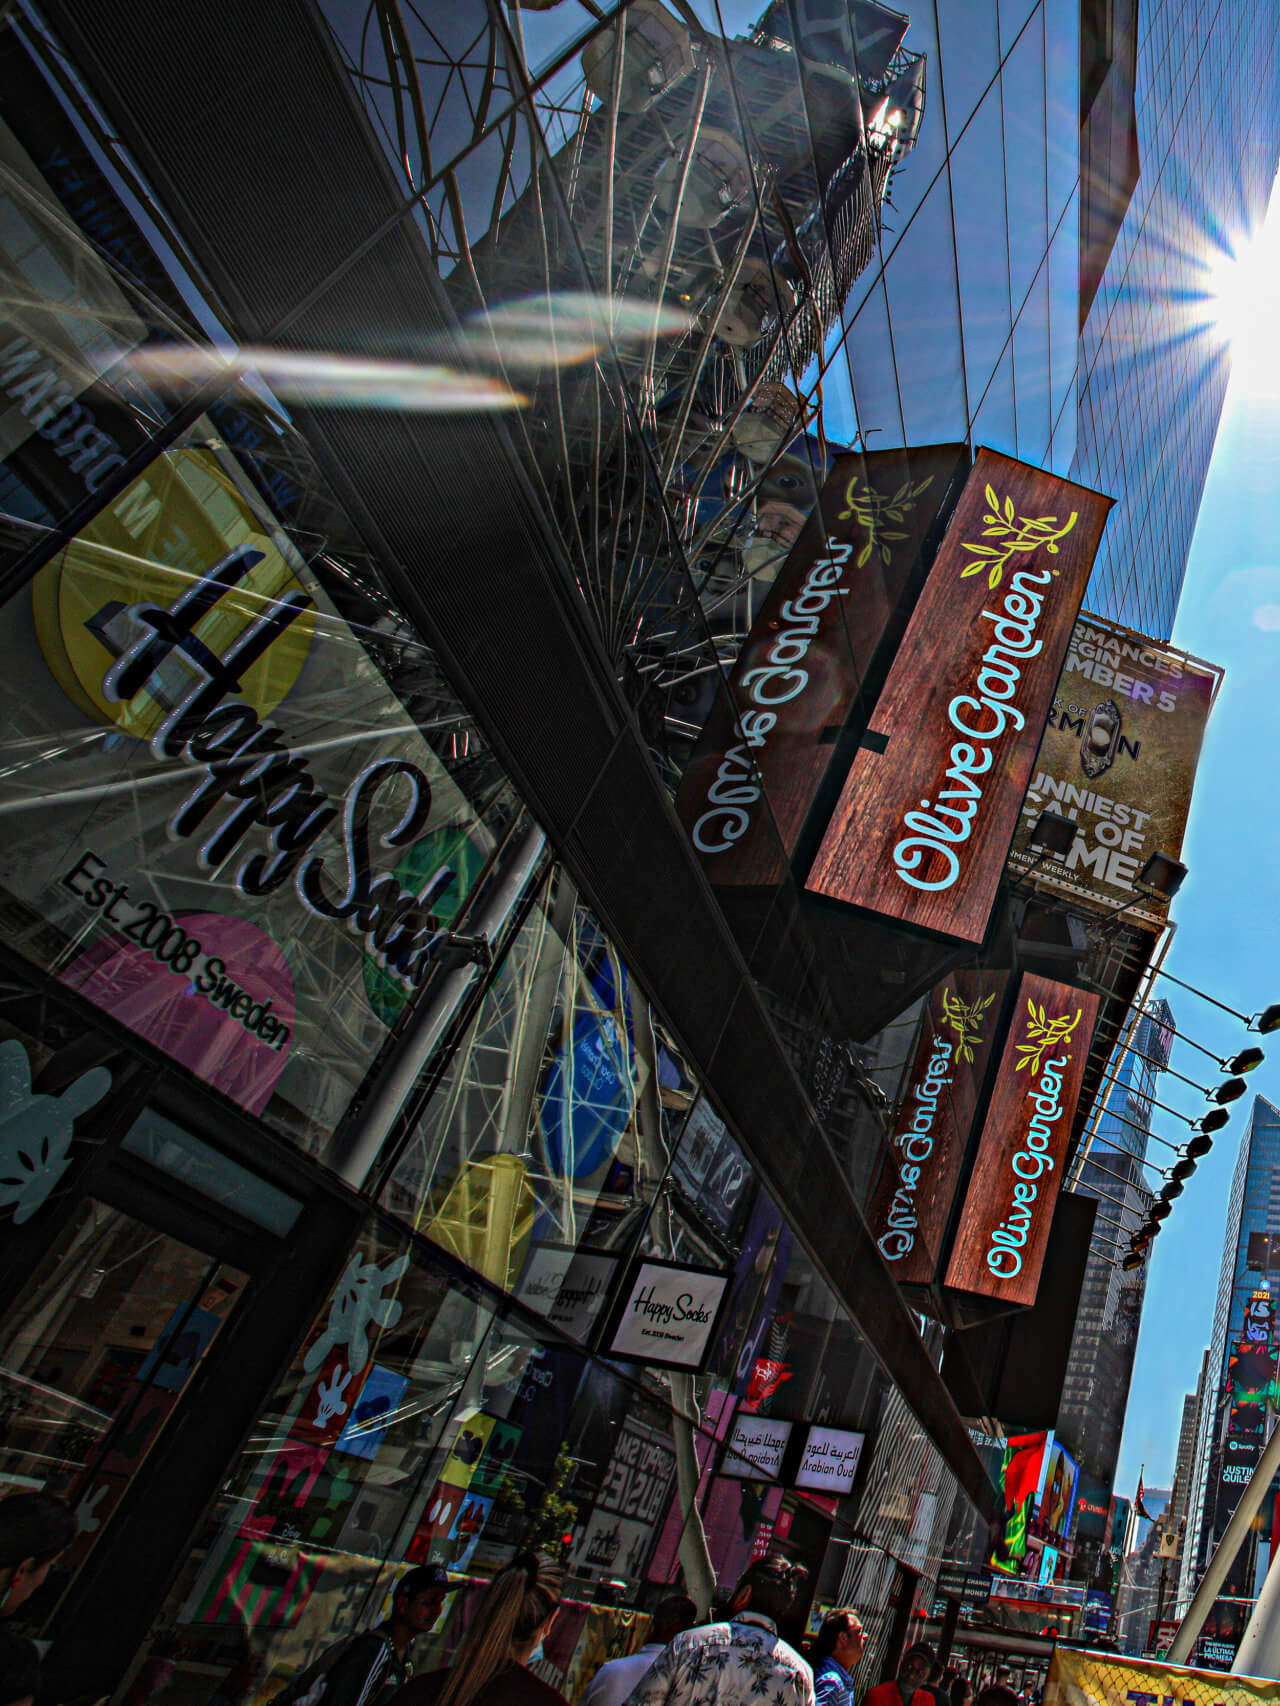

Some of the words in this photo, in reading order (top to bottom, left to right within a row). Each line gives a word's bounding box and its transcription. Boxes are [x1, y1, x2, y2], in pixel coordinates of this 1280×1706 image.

[1067, 702, 1089, 718] OF
[1158, 692, 1177, 713] 5
[892, 738, 993, 893] Olive
[947, 568, 1054, 742] Garden
[1095, 819, 1146, 854] OF
[1041, 861, 1081, 883] WEEKLY
[122, 901, 203, 975] 2008
[194, 957, 291, 1052] Sweden
[1011, 1054, 1069, 1182] Garden
[986, 1182, 1038, 1280] Olive
[633, 1285, 674, 1325] Happy
[672, 1292, 713, 1324] Socks
[1251, 1290, 1270, 1300] 2021
[801, 1458, 835, 1476] Arabian
[836, 1462, 856, 1479] Oud
